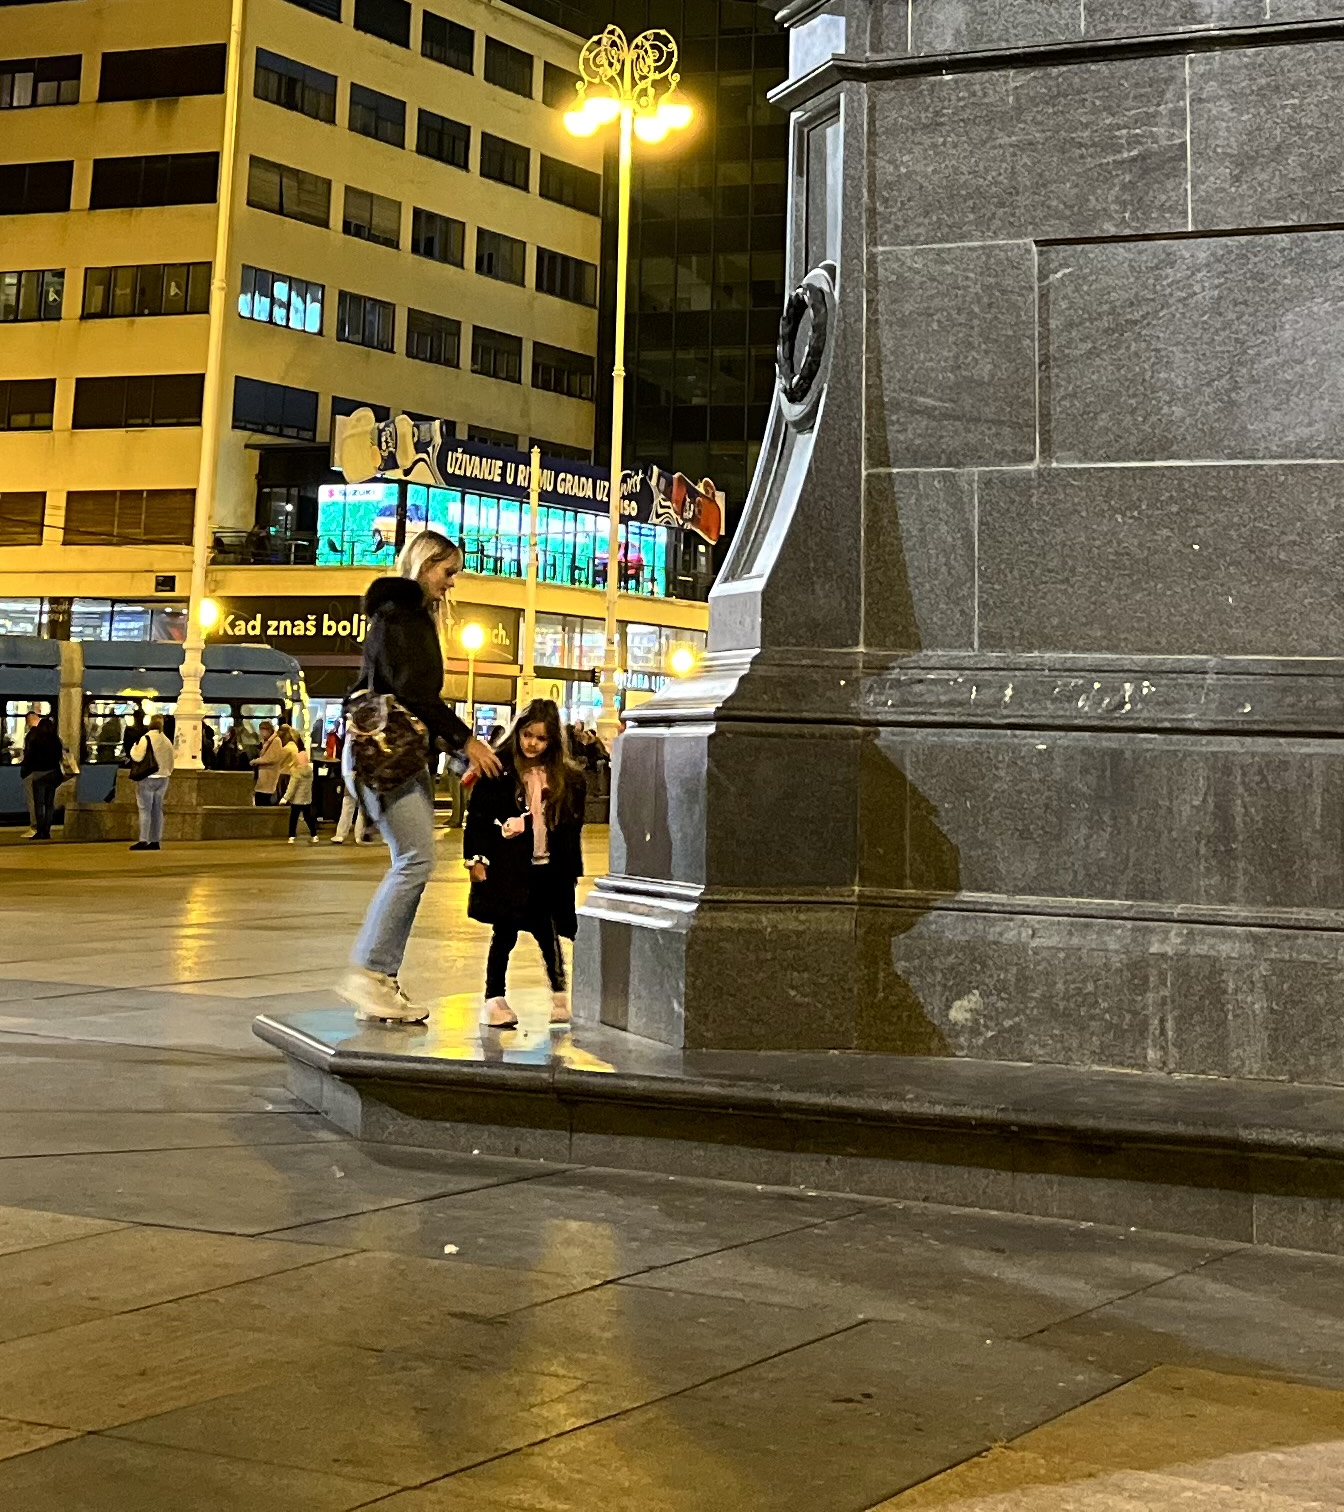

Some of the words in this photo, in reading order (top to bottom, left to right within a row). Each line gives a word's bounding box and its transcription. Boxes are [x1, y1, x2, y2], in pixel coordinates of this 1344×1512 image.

[446, 448, 504, 483] UŽIVANJE
[506, 462, 516, 485] U
[517, 464, 555, 492] RIMU
[556, 472, 594, 499] GRADA
[596, 480, 610, 502] UZ
[218, 614, 262, 636] Kad
[266, 614, 317, 636] znaš
